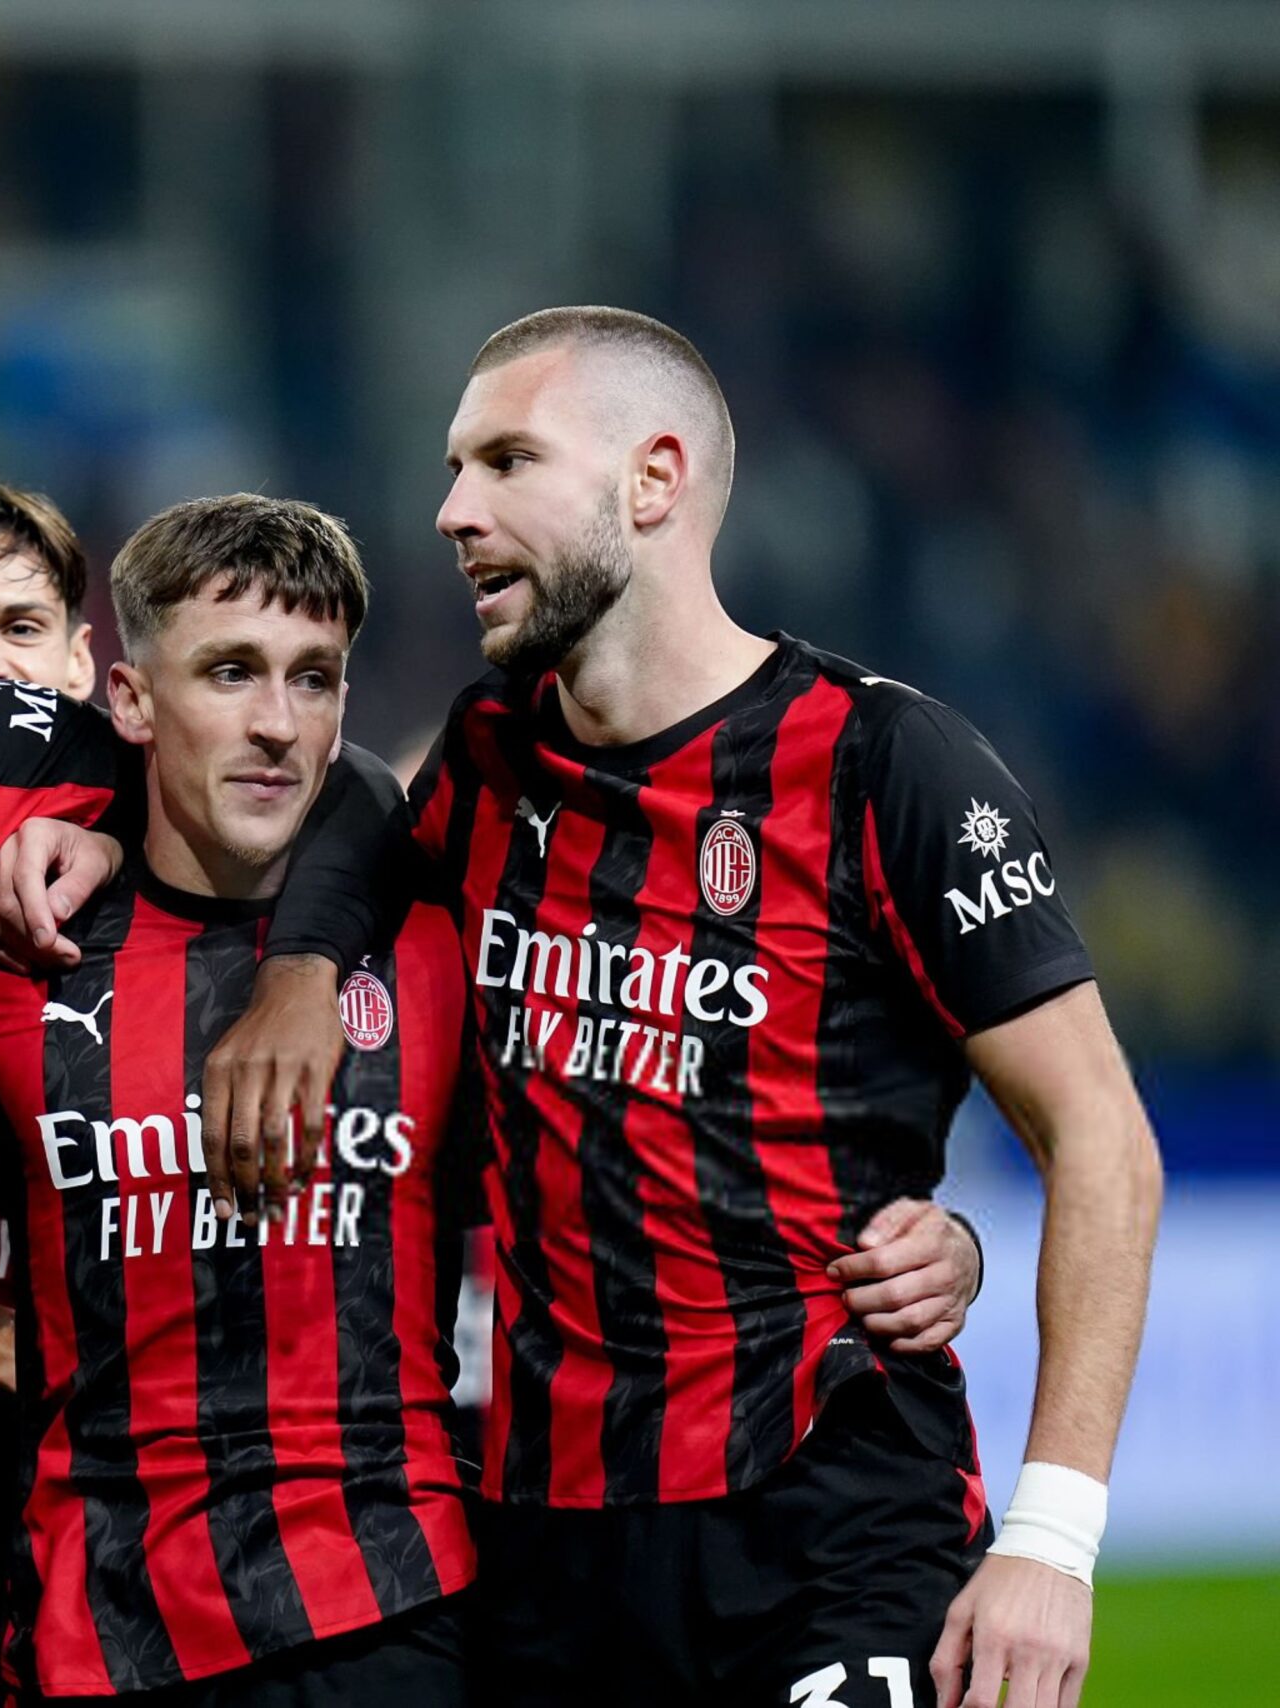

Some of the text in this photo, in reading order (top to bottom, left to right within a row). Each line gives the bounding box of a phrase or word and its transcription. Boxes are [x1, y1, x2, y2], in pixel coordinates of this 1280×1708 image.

[712, 827, 744, 845] ACM
[713, 892, 740, 905] 1899
[943, 851, 1056, 935] MSC
[347, 978, 380, 996] ACM
[475, 908, 770, 1028] Emirates
[352, 1030, 381, 1041] 1899
[500, 1005, 704, 1097] FLY BETTER
[36, 1093, 415, 1190] Emies
[99, 1190, 174, 1261] FLY
